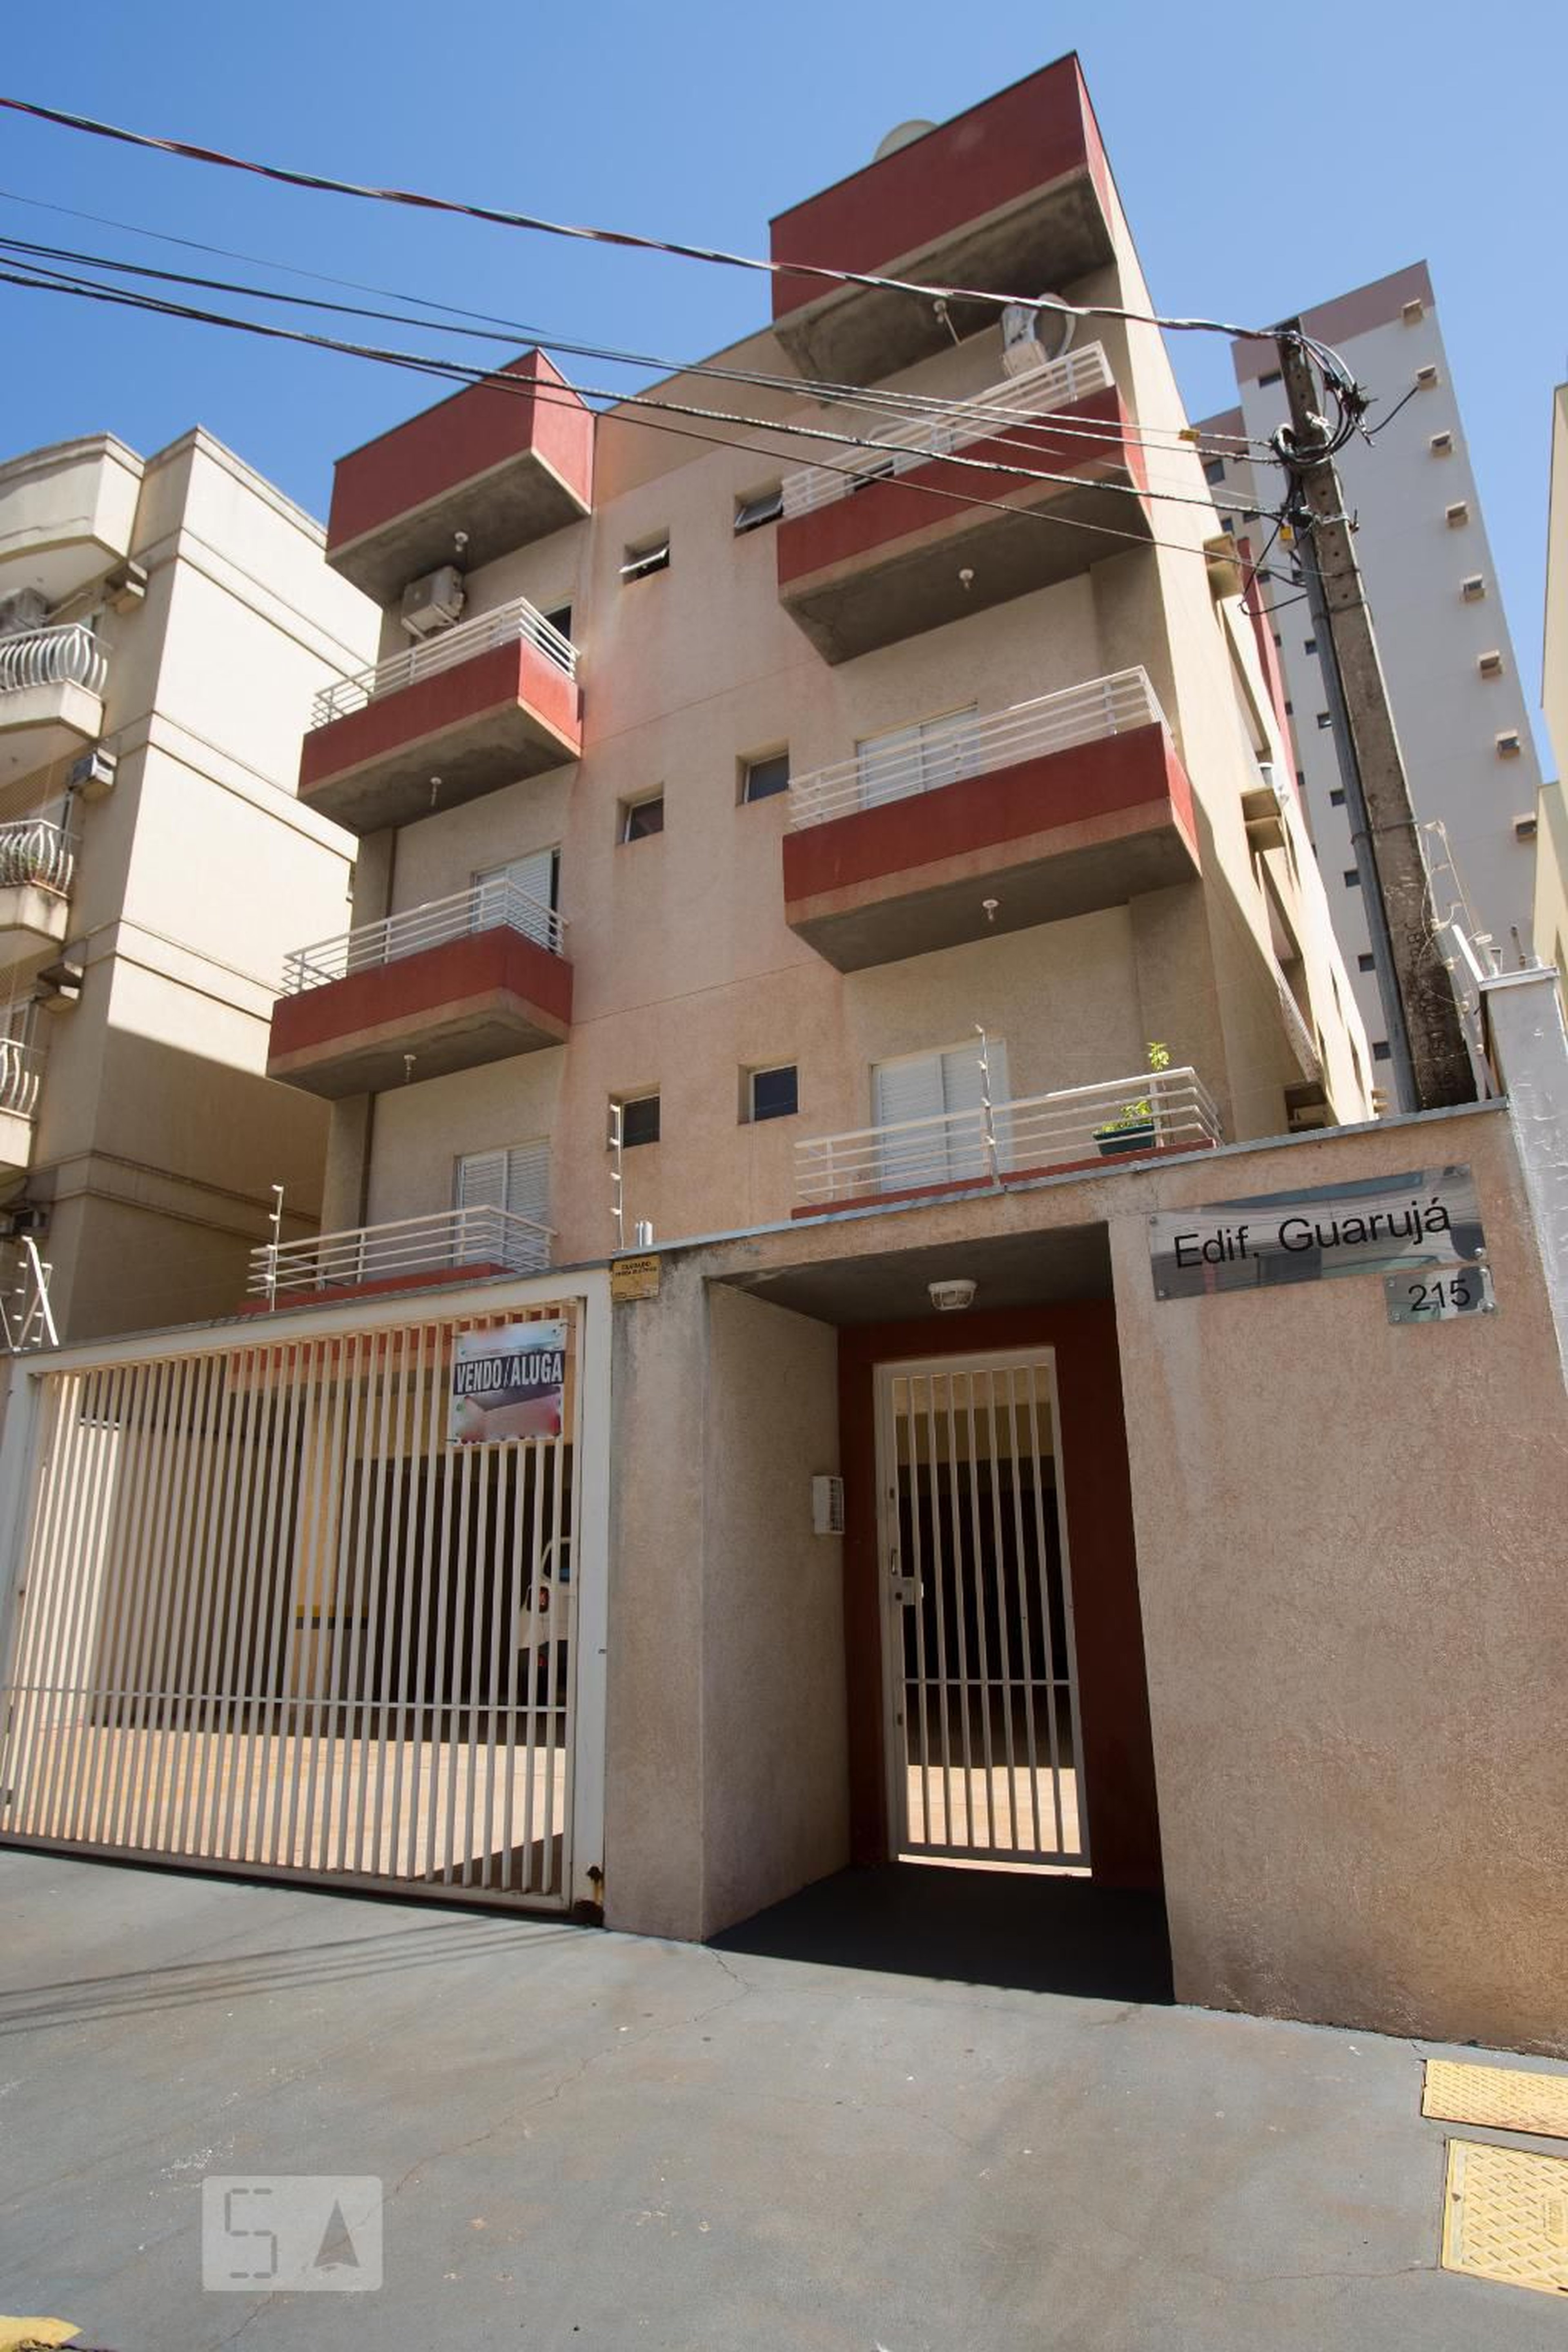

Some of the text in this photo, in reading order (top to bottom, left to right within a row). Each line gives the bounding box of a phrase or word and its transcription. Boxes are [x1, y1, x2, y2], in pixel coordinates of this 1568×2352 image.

[1174, 1197, 1451, 1268] Edif. Guarujá
[1408, 1278, 1471, 1312] 215
